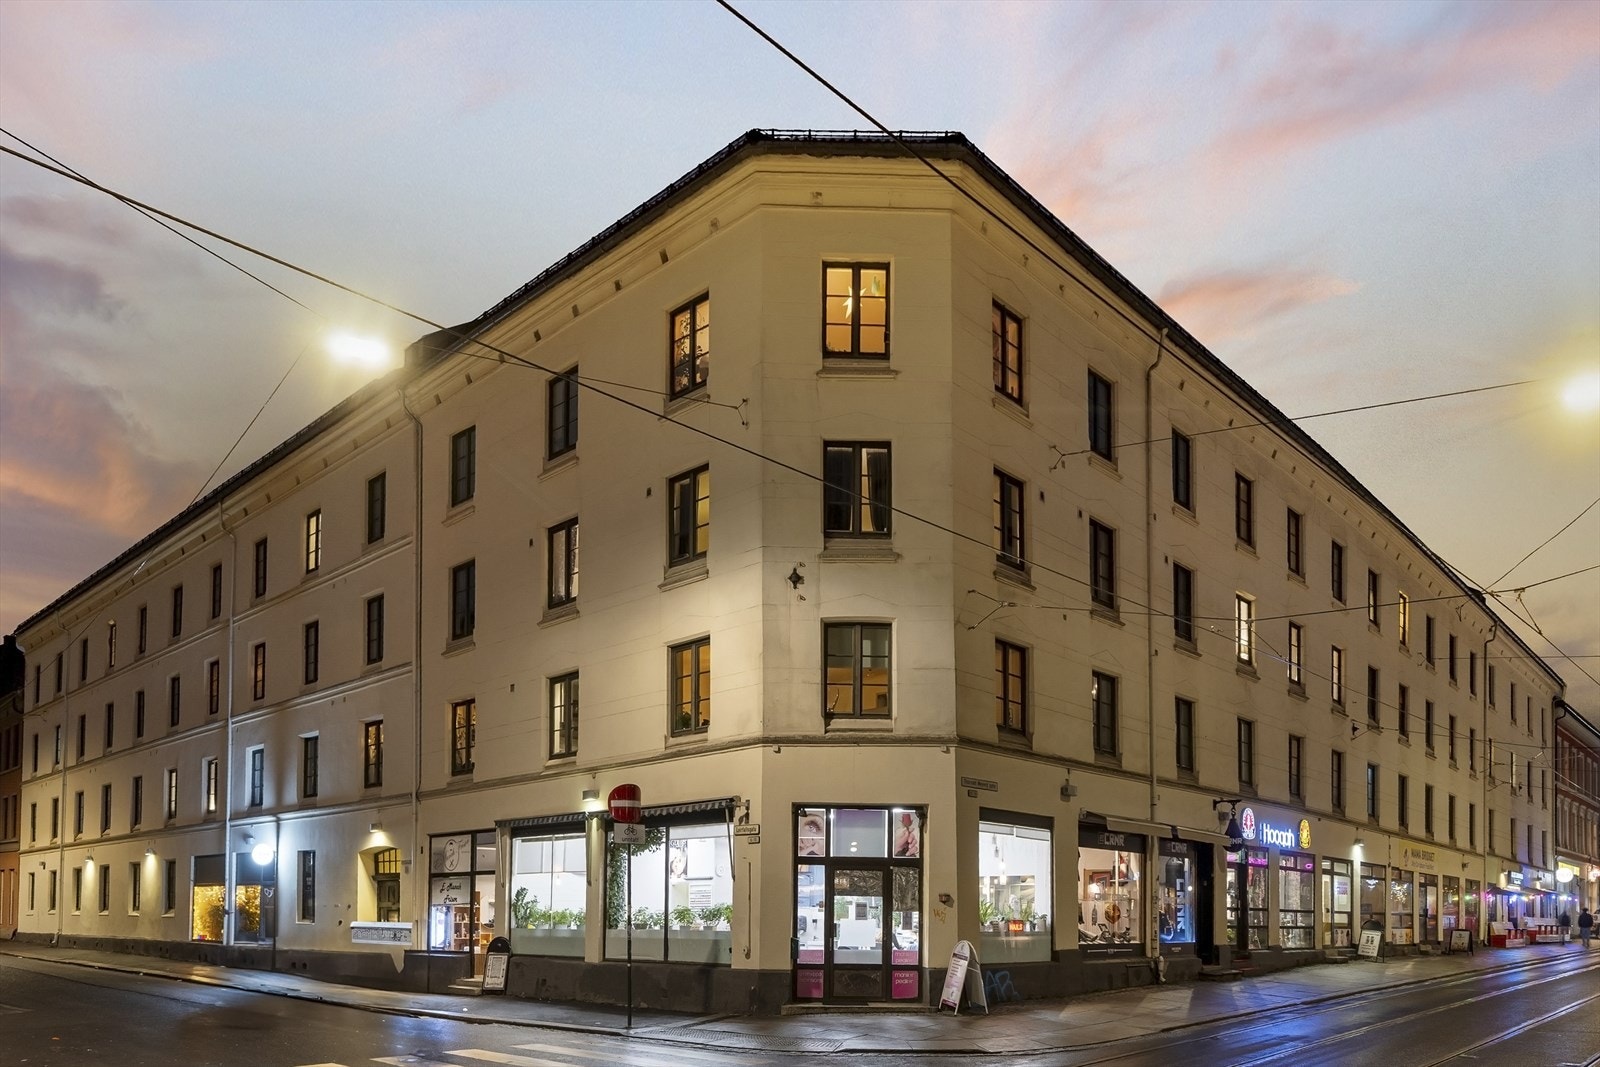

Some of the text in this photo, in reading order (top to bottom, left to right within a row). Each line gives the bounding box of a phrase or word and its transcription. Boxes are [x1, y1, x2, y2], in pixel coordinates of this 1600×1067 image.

[1104, 832, 1125, 847] CRNR
[1171, 842, 1187, 854] CRNR
[1009, 922, 1023, 931] NAILS
